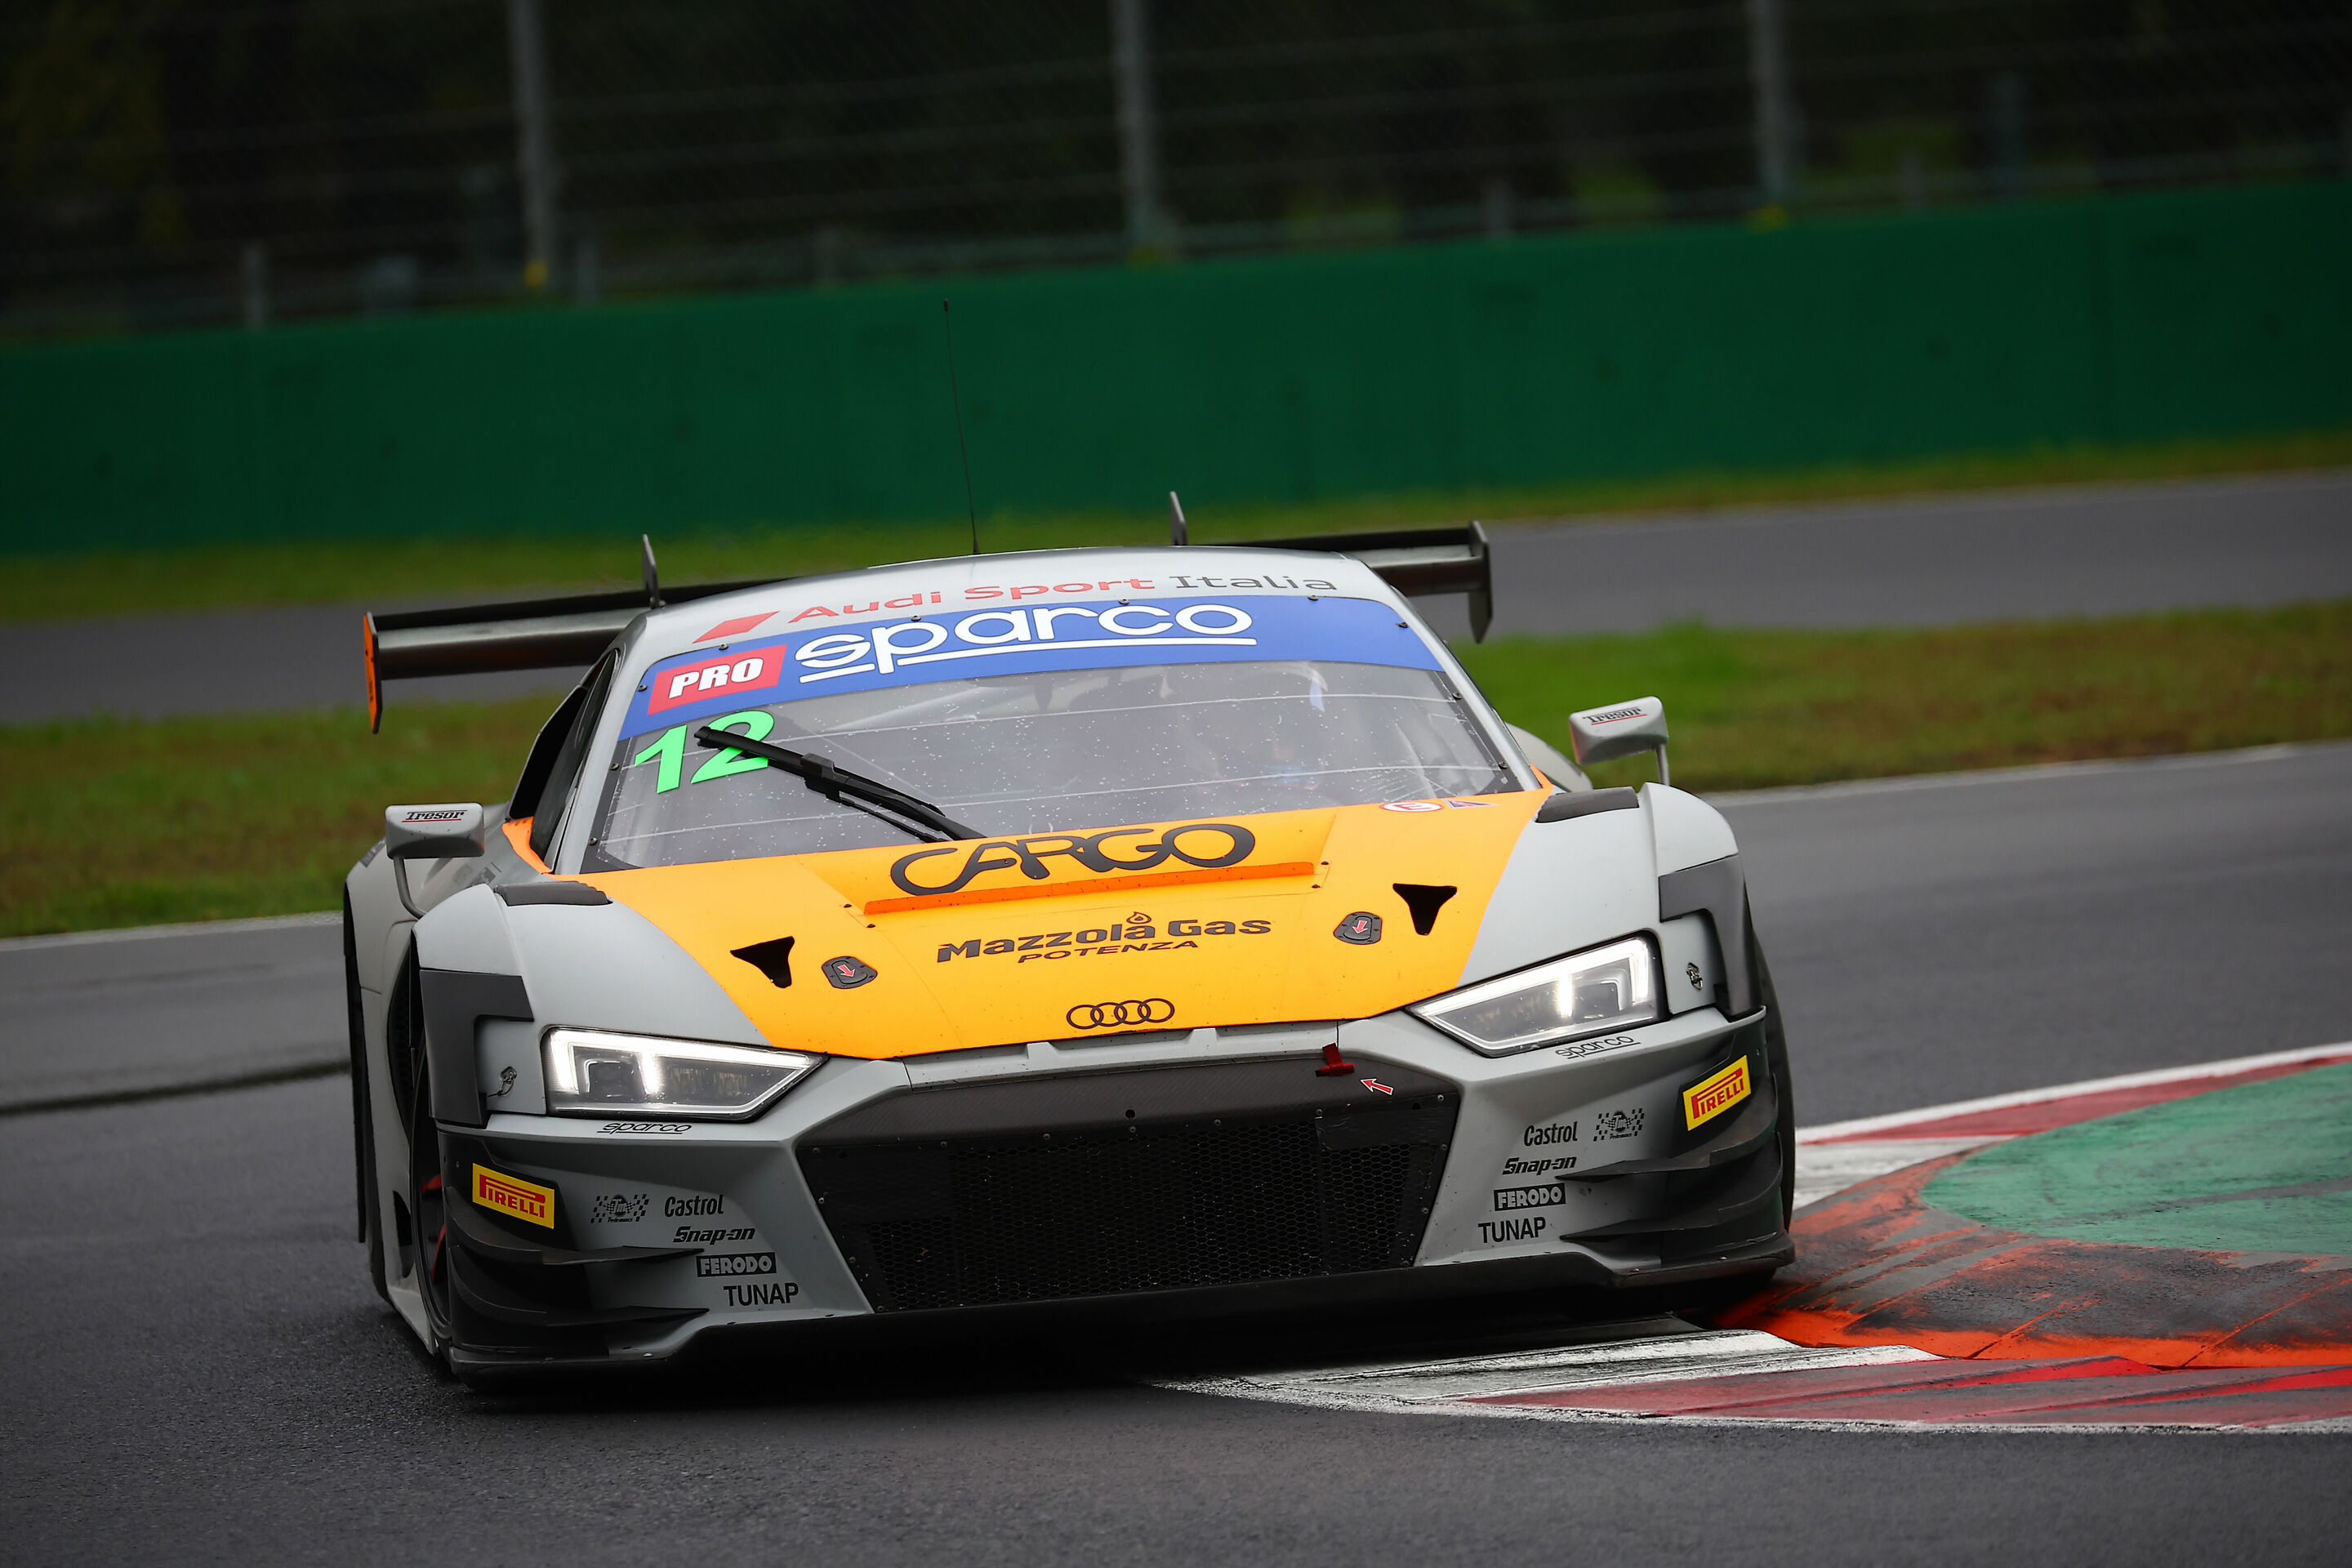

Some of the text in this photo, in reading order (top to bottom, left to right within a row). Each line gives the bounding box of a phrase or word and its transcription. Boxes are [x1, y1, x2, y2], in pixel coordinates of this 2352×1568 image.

[789, 575, 1338, 623] Audi Sport Italia
[795, 604, 1254, 675] sparco
[669, 657, 764, 699] PRO
[1583, 707, 1642, 723] Tresor
[635, 710, 775, 794] 12
[405, 809, 467, 820] Tresor
[890, 823, 1256, 896] CARGO
[1168, 919, 1272, 937] Gas
[1018, 940, 1199, 964] POTENZA
[1555, 1035, 1634, 1058] sparco
[1691, 1067, 1744, 1120] PIRELLI
[602, 1122, 693, 1134] sparco
[1524, 1121, 1578, 1147] Castrol
[1502, 1156, 1577, 1175] Snap-on
[479, 1174, 546, 1218] PIRELLI
[664, 1194, 724, 1217] Castrol
[1497, 1187, 1562, 1209] FERODO
[673, 1226, 756, 1245] Snap-on
[1478, 1217, 1546, 1244] TUNAP
[701, 1255, 773, 1276] FERODO
[724, 1282, 799, 1307] TUNAP
